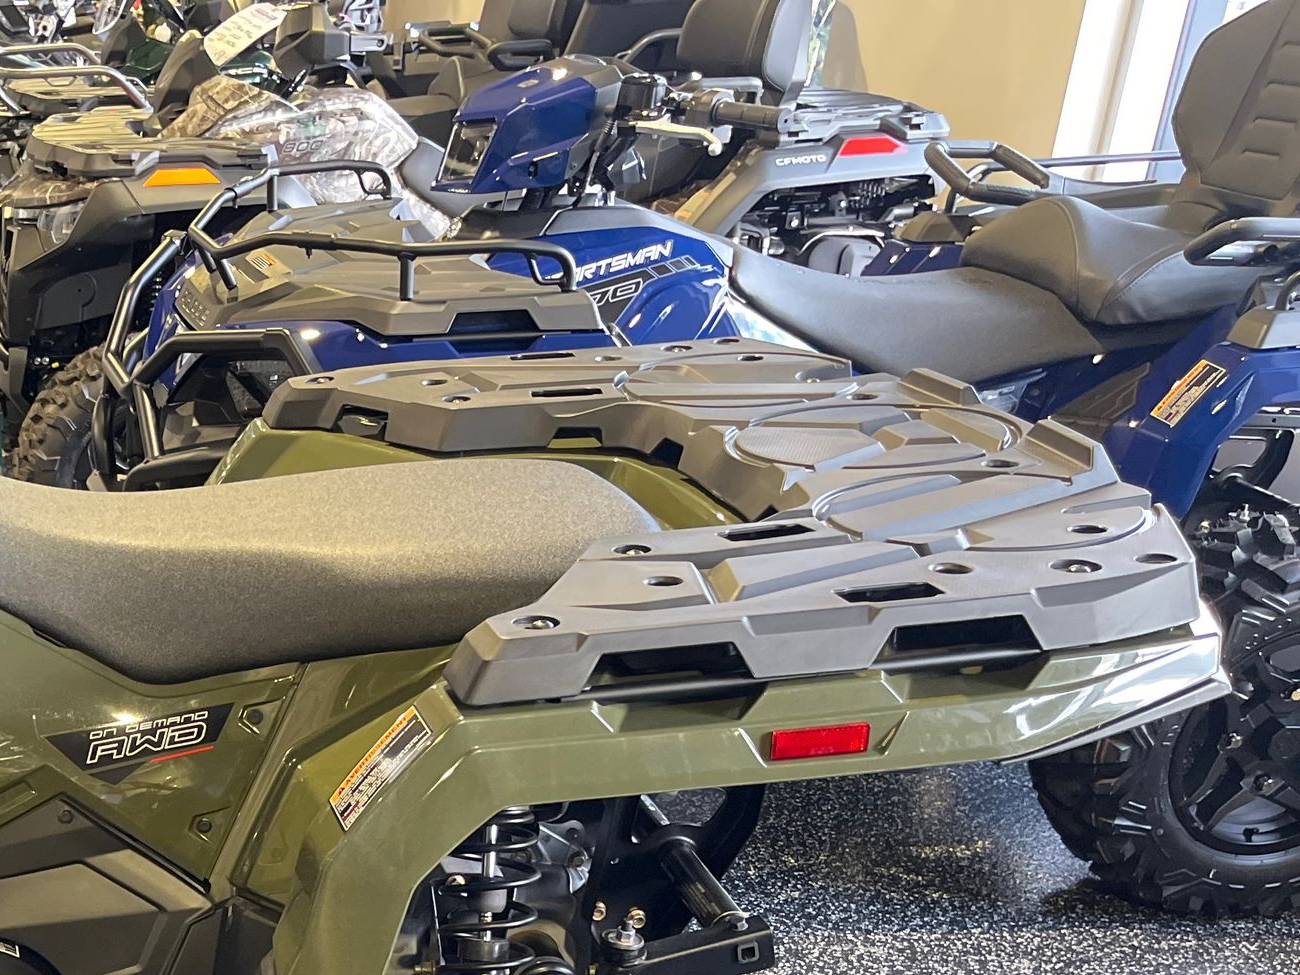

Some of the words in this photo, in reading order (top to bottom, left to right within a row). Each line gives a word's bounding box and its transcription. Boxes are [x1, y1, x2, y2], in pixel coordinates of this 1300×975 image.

[775, 154, 827, 167] CFMOTO
[545, 239, 674, 282] RTSMAN
[590, 278, 644, 307] 70
[89, 727, 117, 740] ON
[125, 710, 209, 734] DEMAND
[86, 721, 207, 765] AWD
